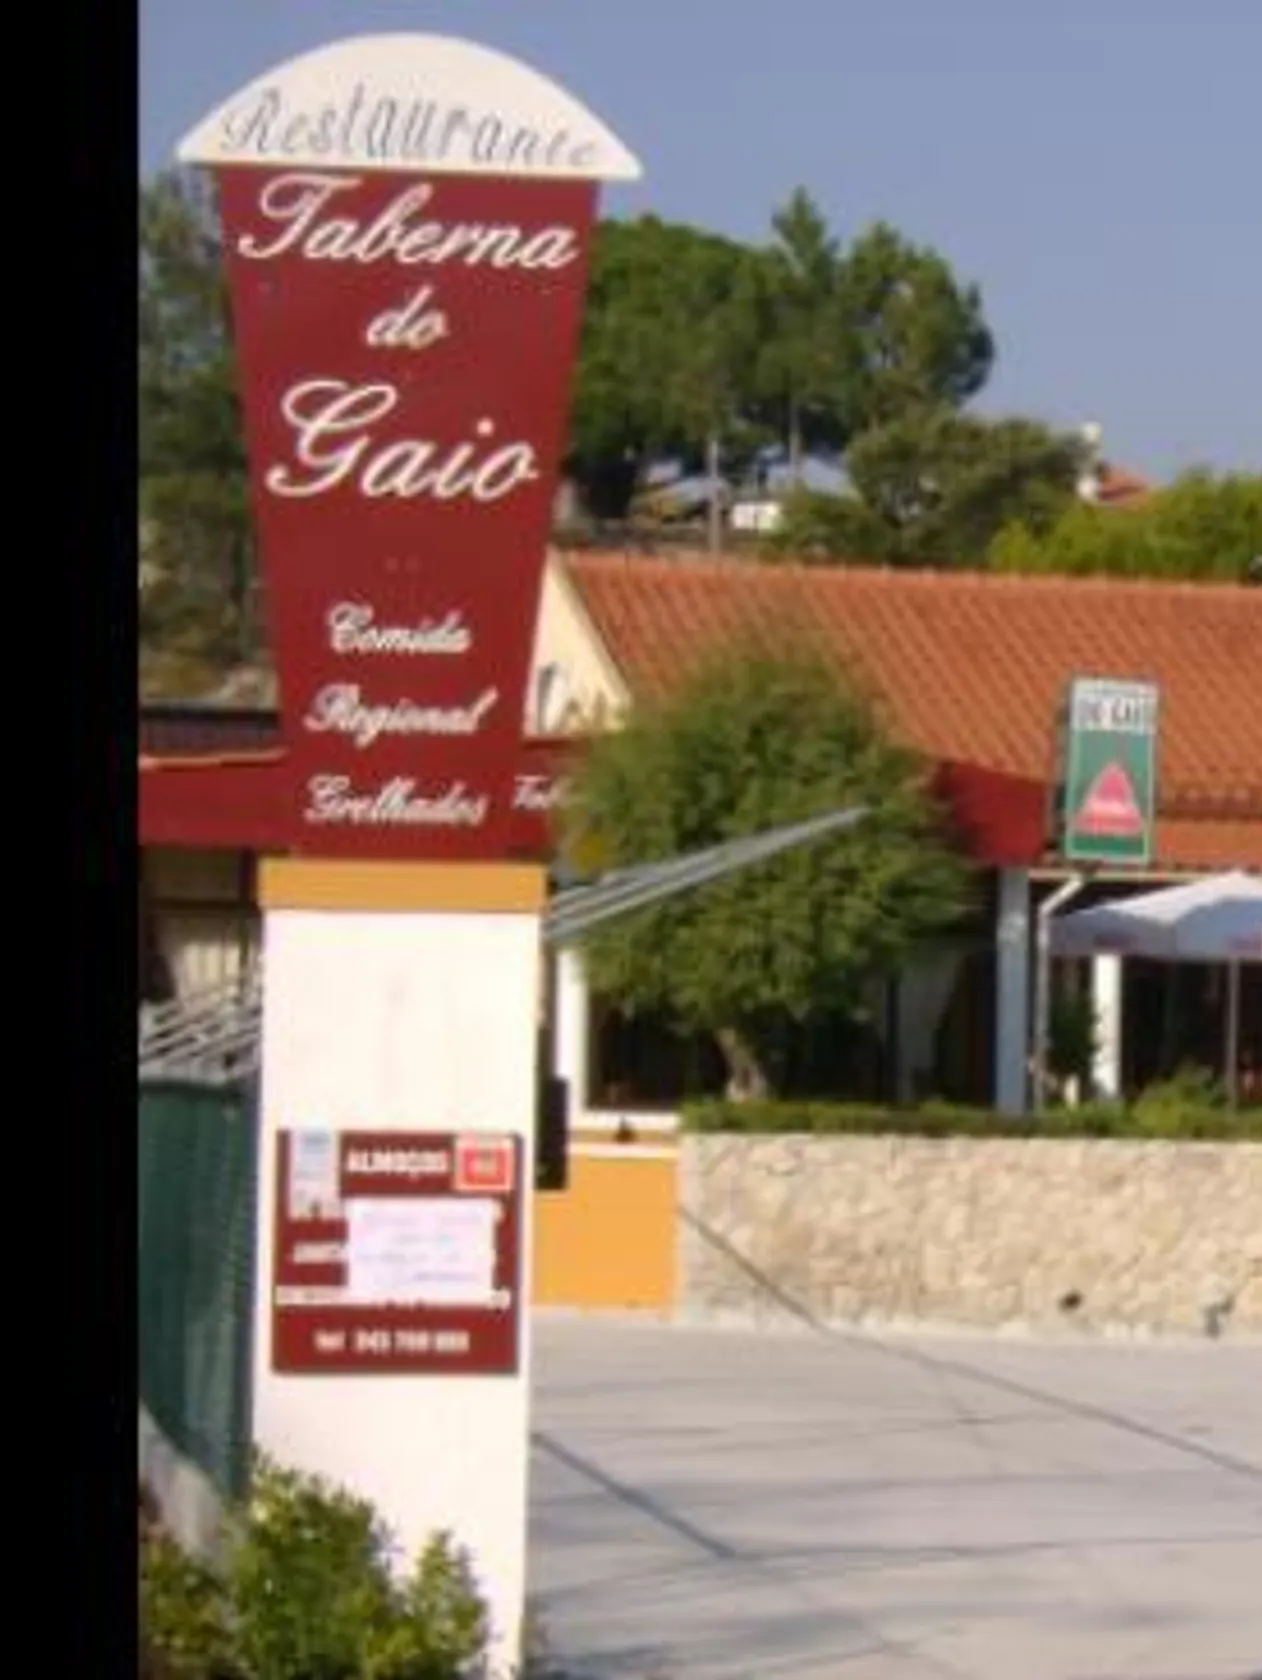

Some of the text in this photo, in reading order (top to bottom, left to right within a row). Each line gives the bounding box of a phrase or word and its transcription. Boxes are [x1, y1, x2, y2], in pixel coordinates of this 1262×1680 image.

[220, 82, 602, 169] Restaurante
[237, 173, 581, 270] Taberna
[365, 283, 450, 349] do
[266, 377, 539, 501] Gaio
[328, 601, 473, 653] Comida
[303, 683, 499, 749] Regional
[304, 773, 490, 826] Grelhados
